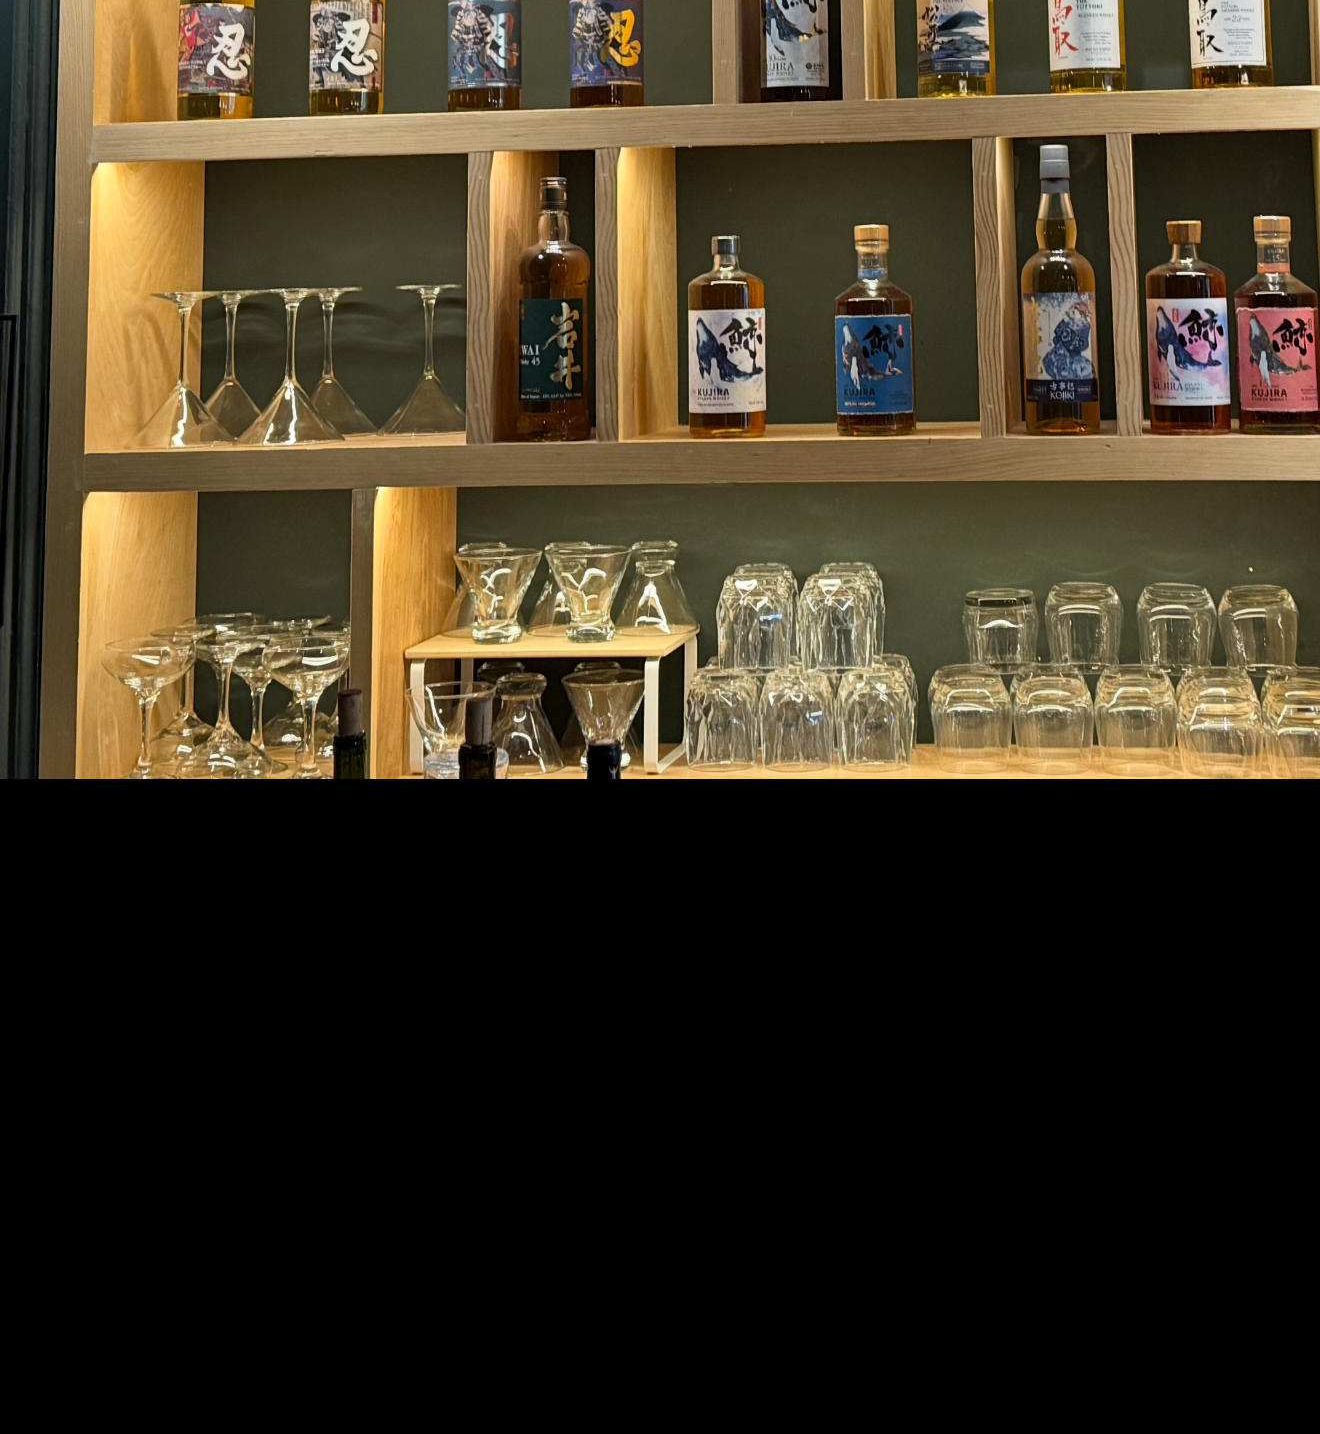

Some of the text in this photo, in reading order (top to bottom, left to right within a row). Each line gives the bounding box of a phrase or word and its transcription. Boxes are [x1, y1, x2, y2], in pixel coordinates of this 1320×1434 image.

[530, 355, 541, 366] 45
[1152, 381, 1184, 392] KUJIRA
[697, 387, 731, 397] KUJIRA
[1049, 391, 1075, 401] KOJIKI
[1251, 388, 1288, 398] KUJIRA
